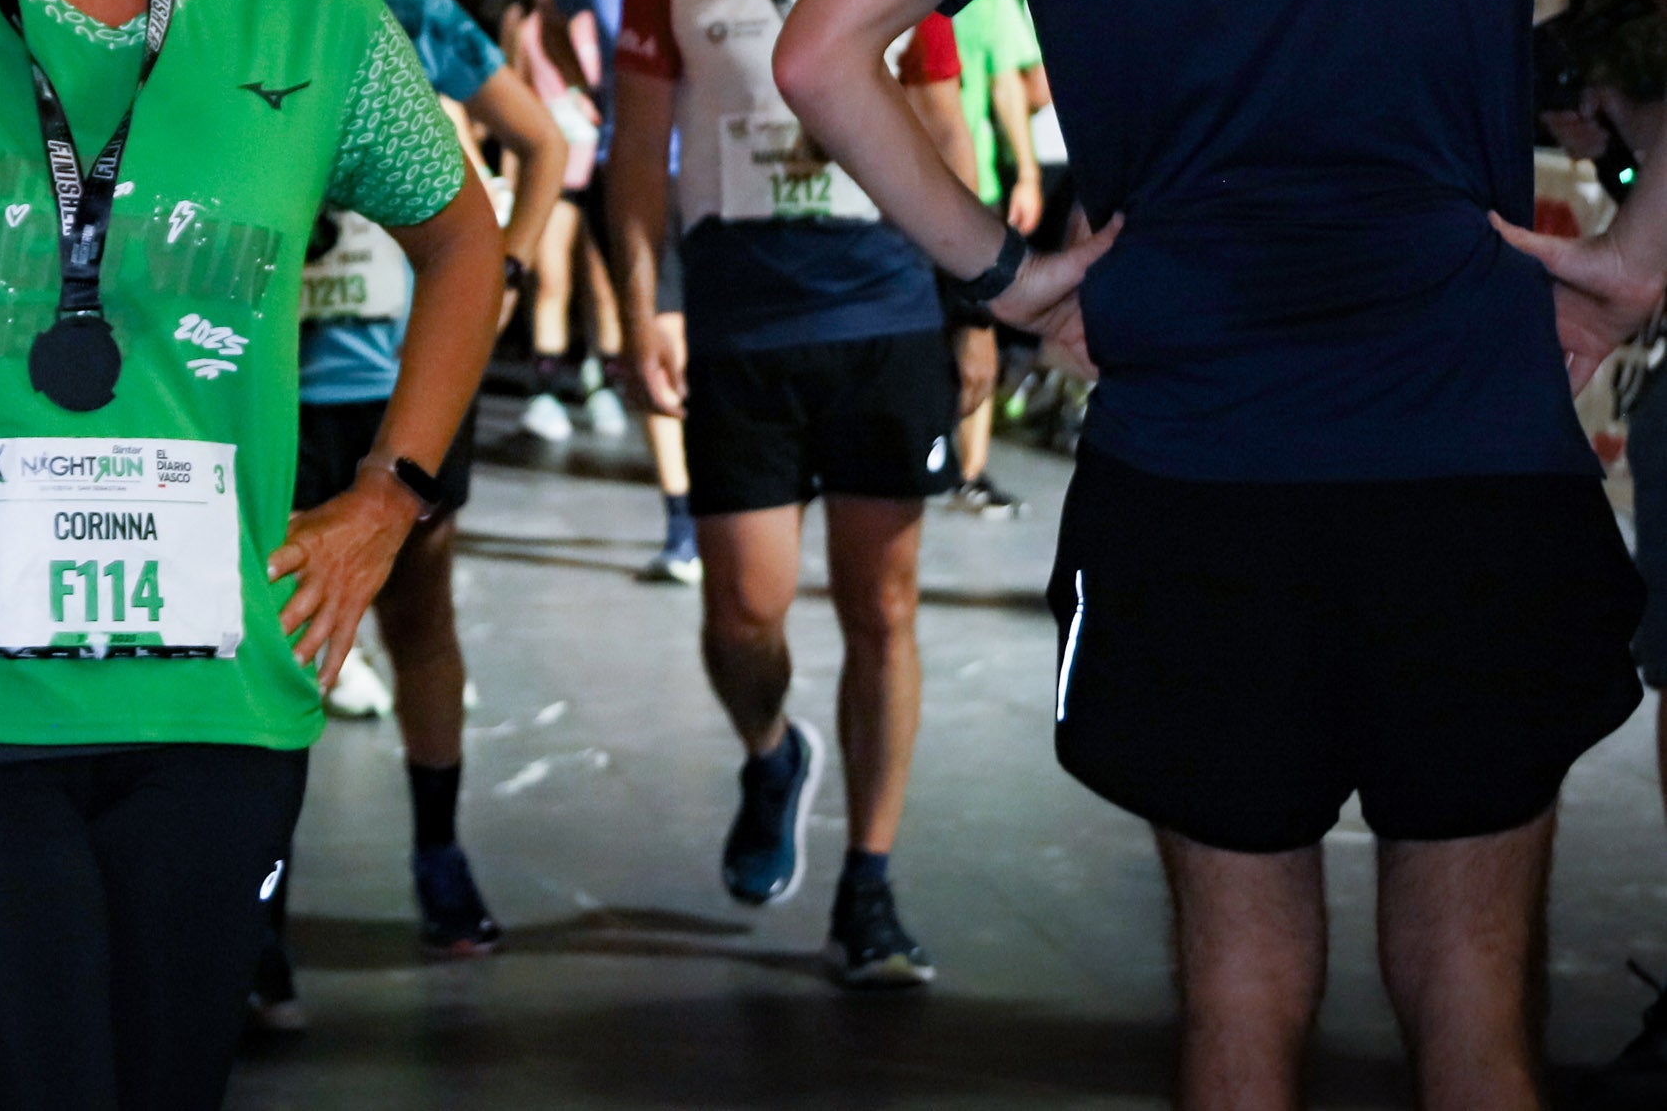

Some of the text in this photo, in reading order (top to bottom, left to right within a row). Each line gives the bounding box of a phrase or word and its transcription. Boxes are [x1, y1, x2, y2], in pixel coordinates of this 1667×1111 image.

[303, 274, 368, 308] 1213
[173, 312, 250, 356] 2025
[111, 444, 144, 457] Binter
[156, 449, 168, 460] EL
[156, 460, 192, 473] DIARIO
[157, 472, 192, 484] VASCO
[213, 463, 226, 495] 3
[53, 510, 159, 542] CORINNA
[48, 559, 165, 623] F114
